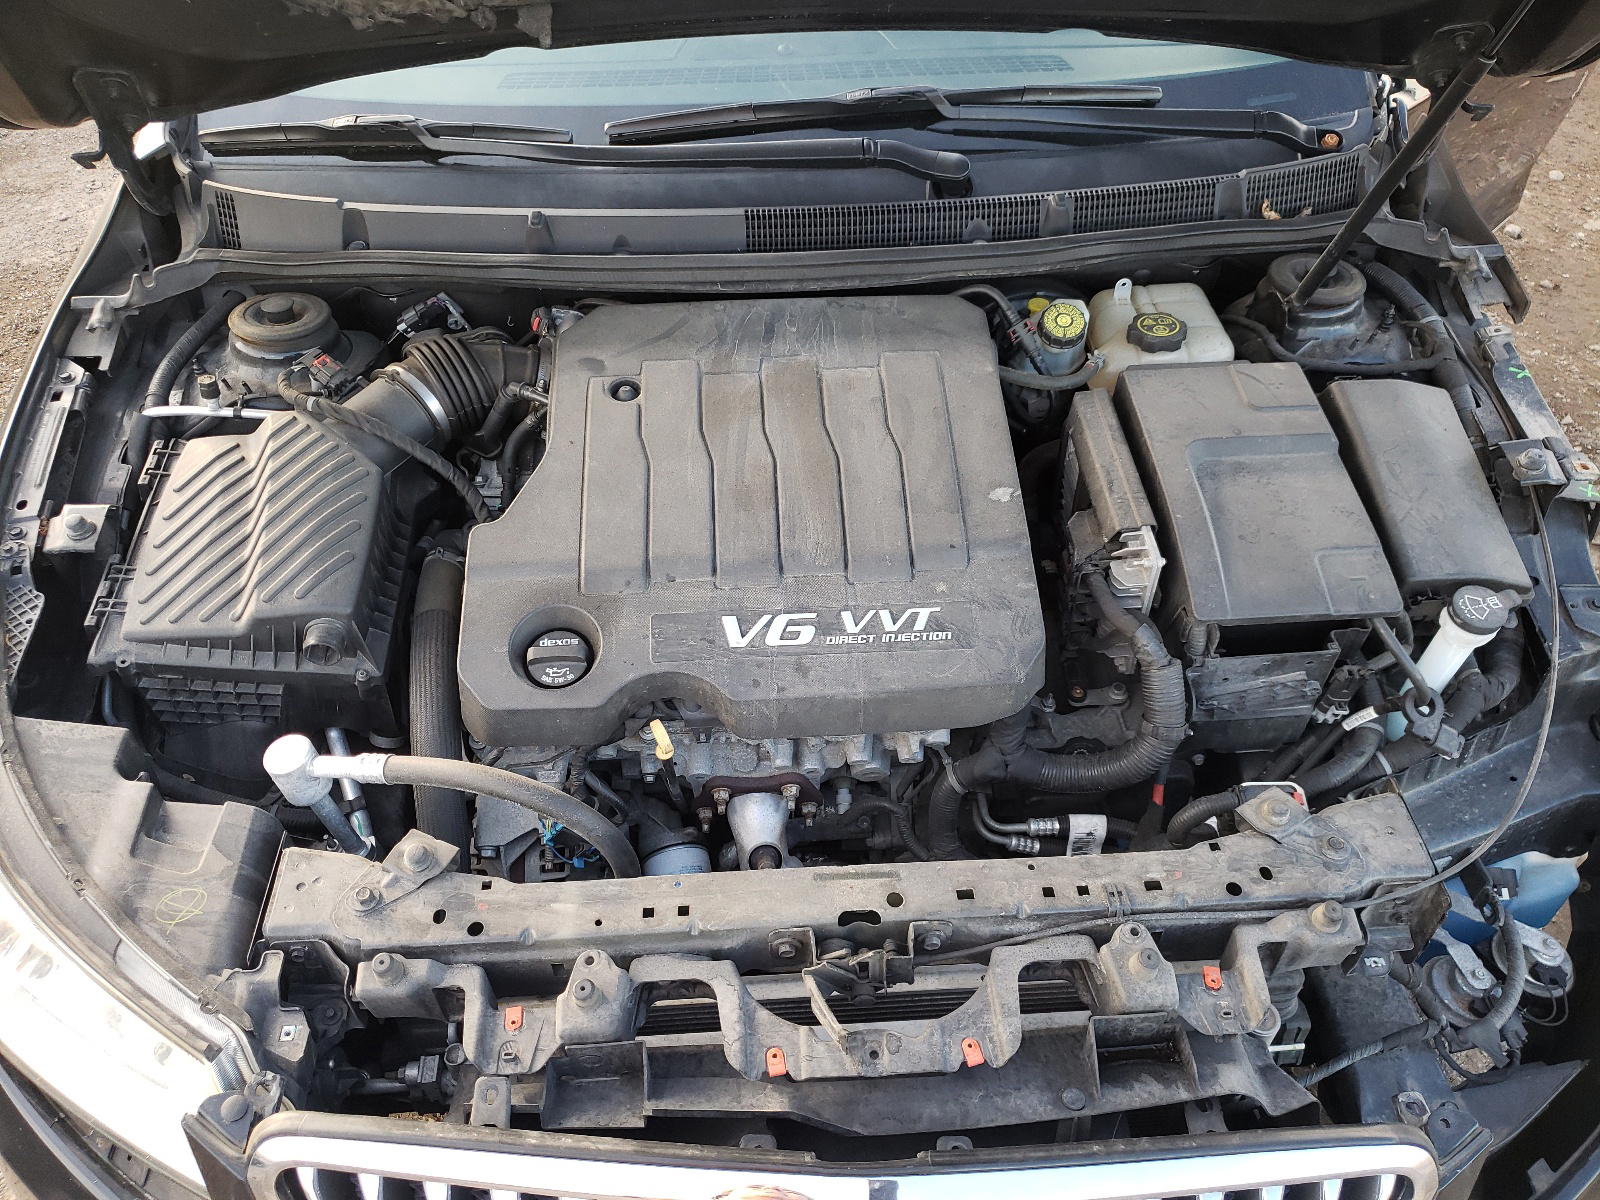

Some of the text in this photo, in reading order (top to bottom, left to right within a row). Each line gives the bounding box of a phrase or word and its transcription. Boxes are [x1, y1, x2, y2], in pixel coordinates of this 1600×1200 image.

[721, 606, 941, 648] V6 VVT
[540, 638, 579, 647] dexos
[826, 631, 952, 645] DIRECT INJECTION
